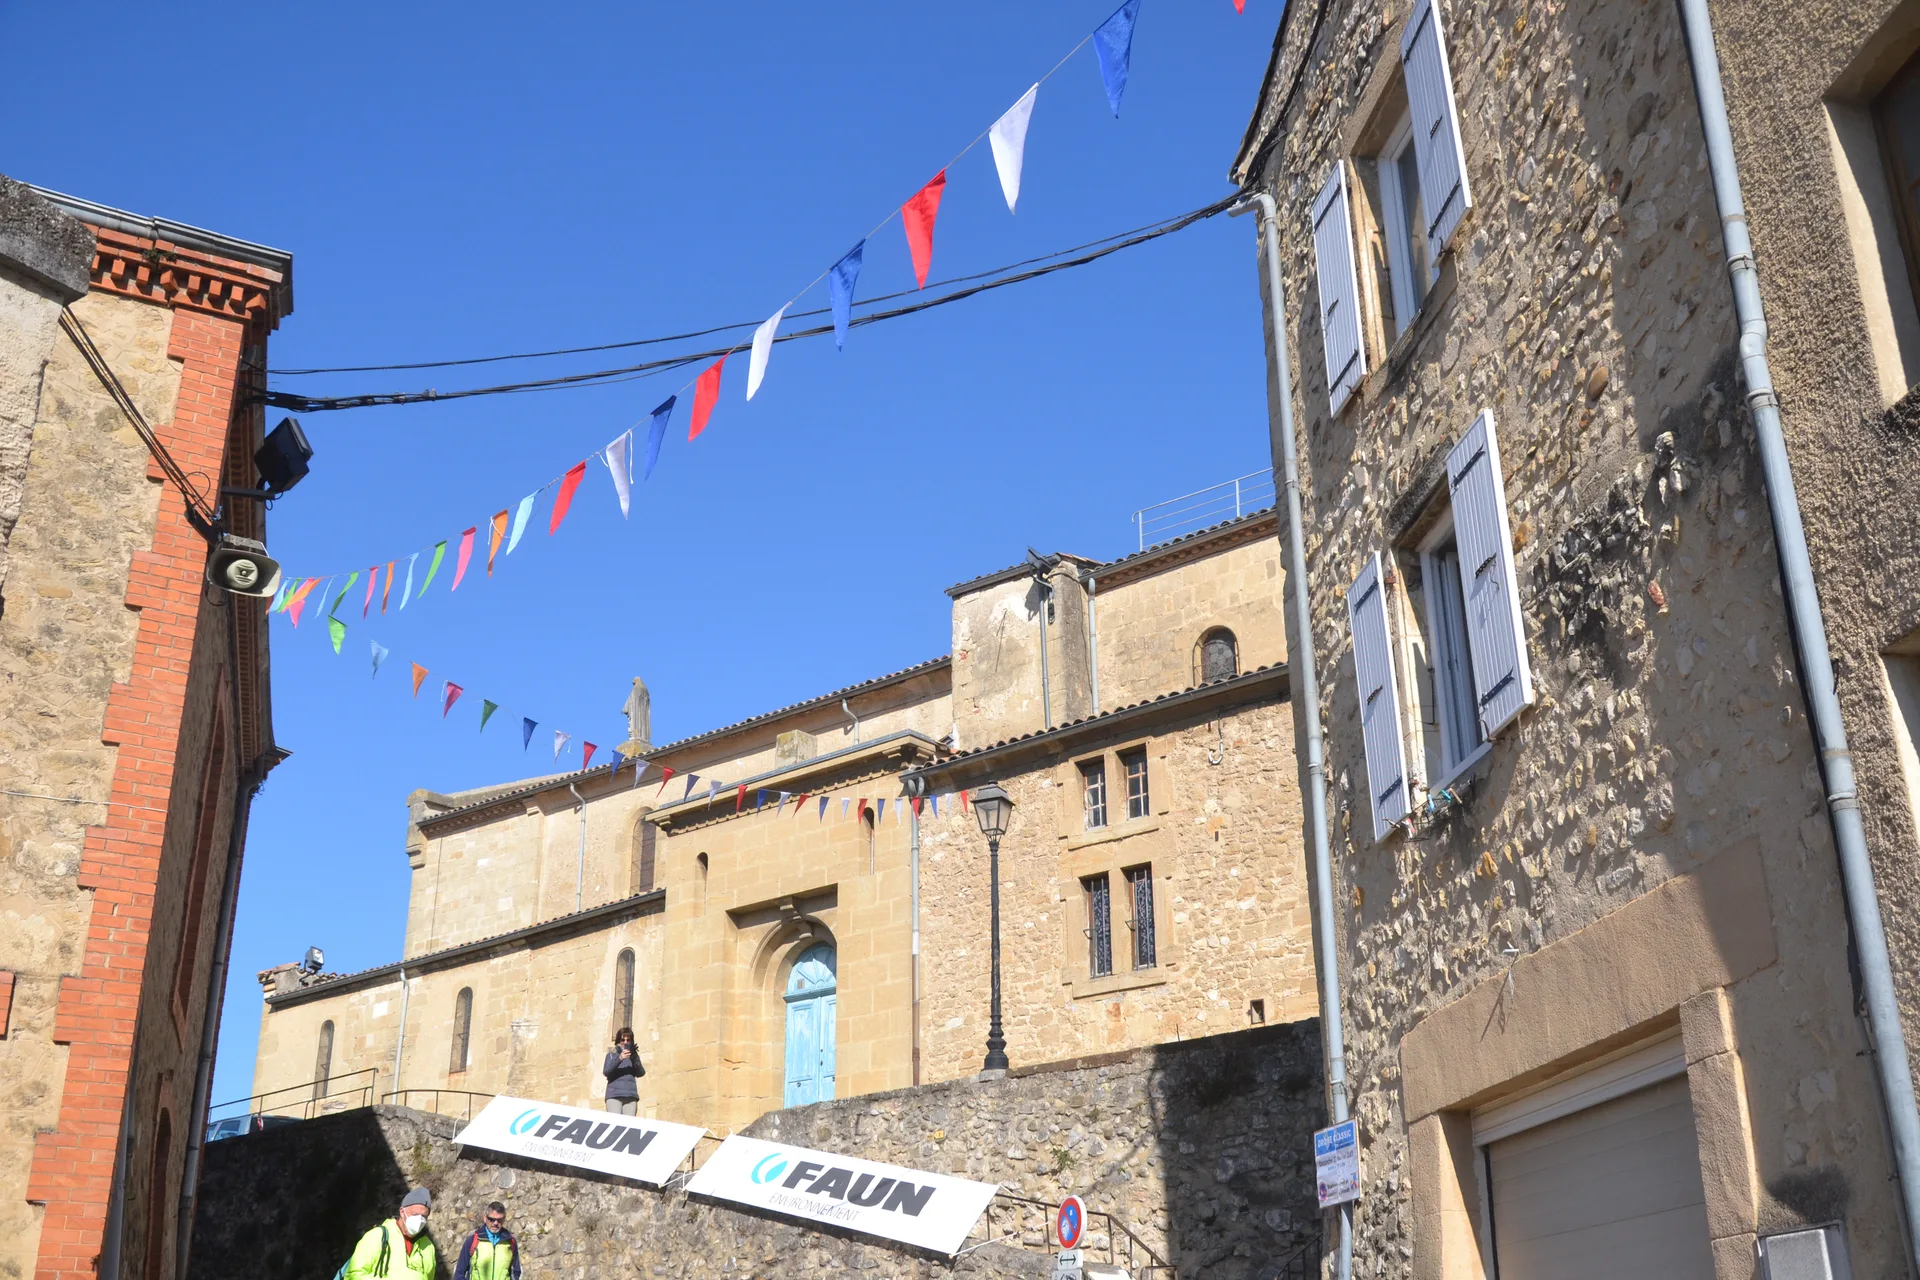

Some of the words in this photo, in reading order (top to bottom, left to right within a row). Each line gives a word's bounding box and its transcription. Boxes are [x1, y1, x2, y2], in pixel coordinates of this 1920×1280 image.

[522, 1141, 596, 1163] ENVIRONNEMENT
[533, 1114, 658, 1156] FAUN
[781, 1160, 937, 1217] FAUN
[768, 1192, 861, 1221] ENVIRONNEMENT
